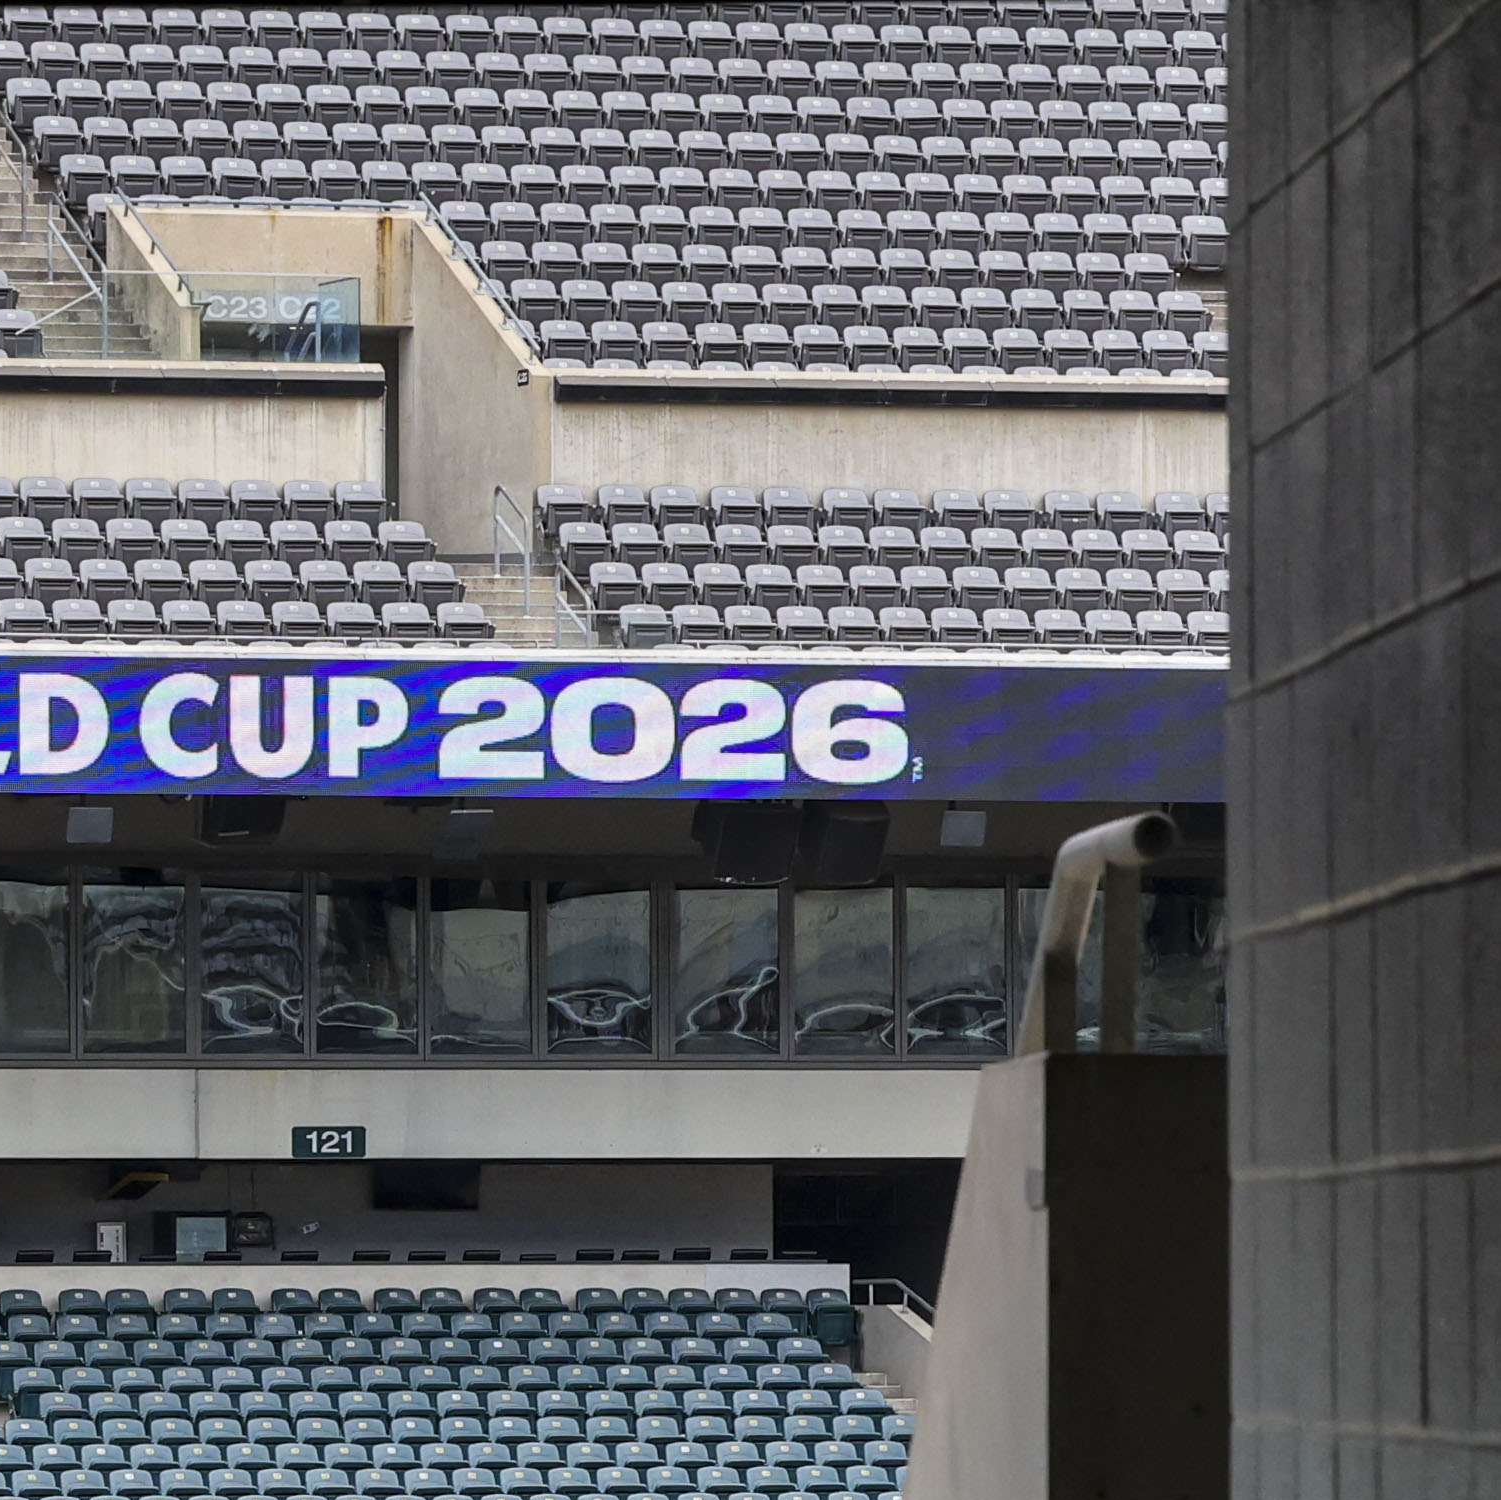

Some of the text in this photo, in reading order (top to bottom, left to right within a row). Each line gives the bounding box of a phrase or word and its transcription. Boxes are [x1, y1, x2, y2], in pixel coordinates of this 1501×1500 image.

[206, 294, 268, 319] C23
[139, 671, 409, 779] CUP
[438, 675, 909, 784] 2026
[305, 1130, 352, 1153] 121
